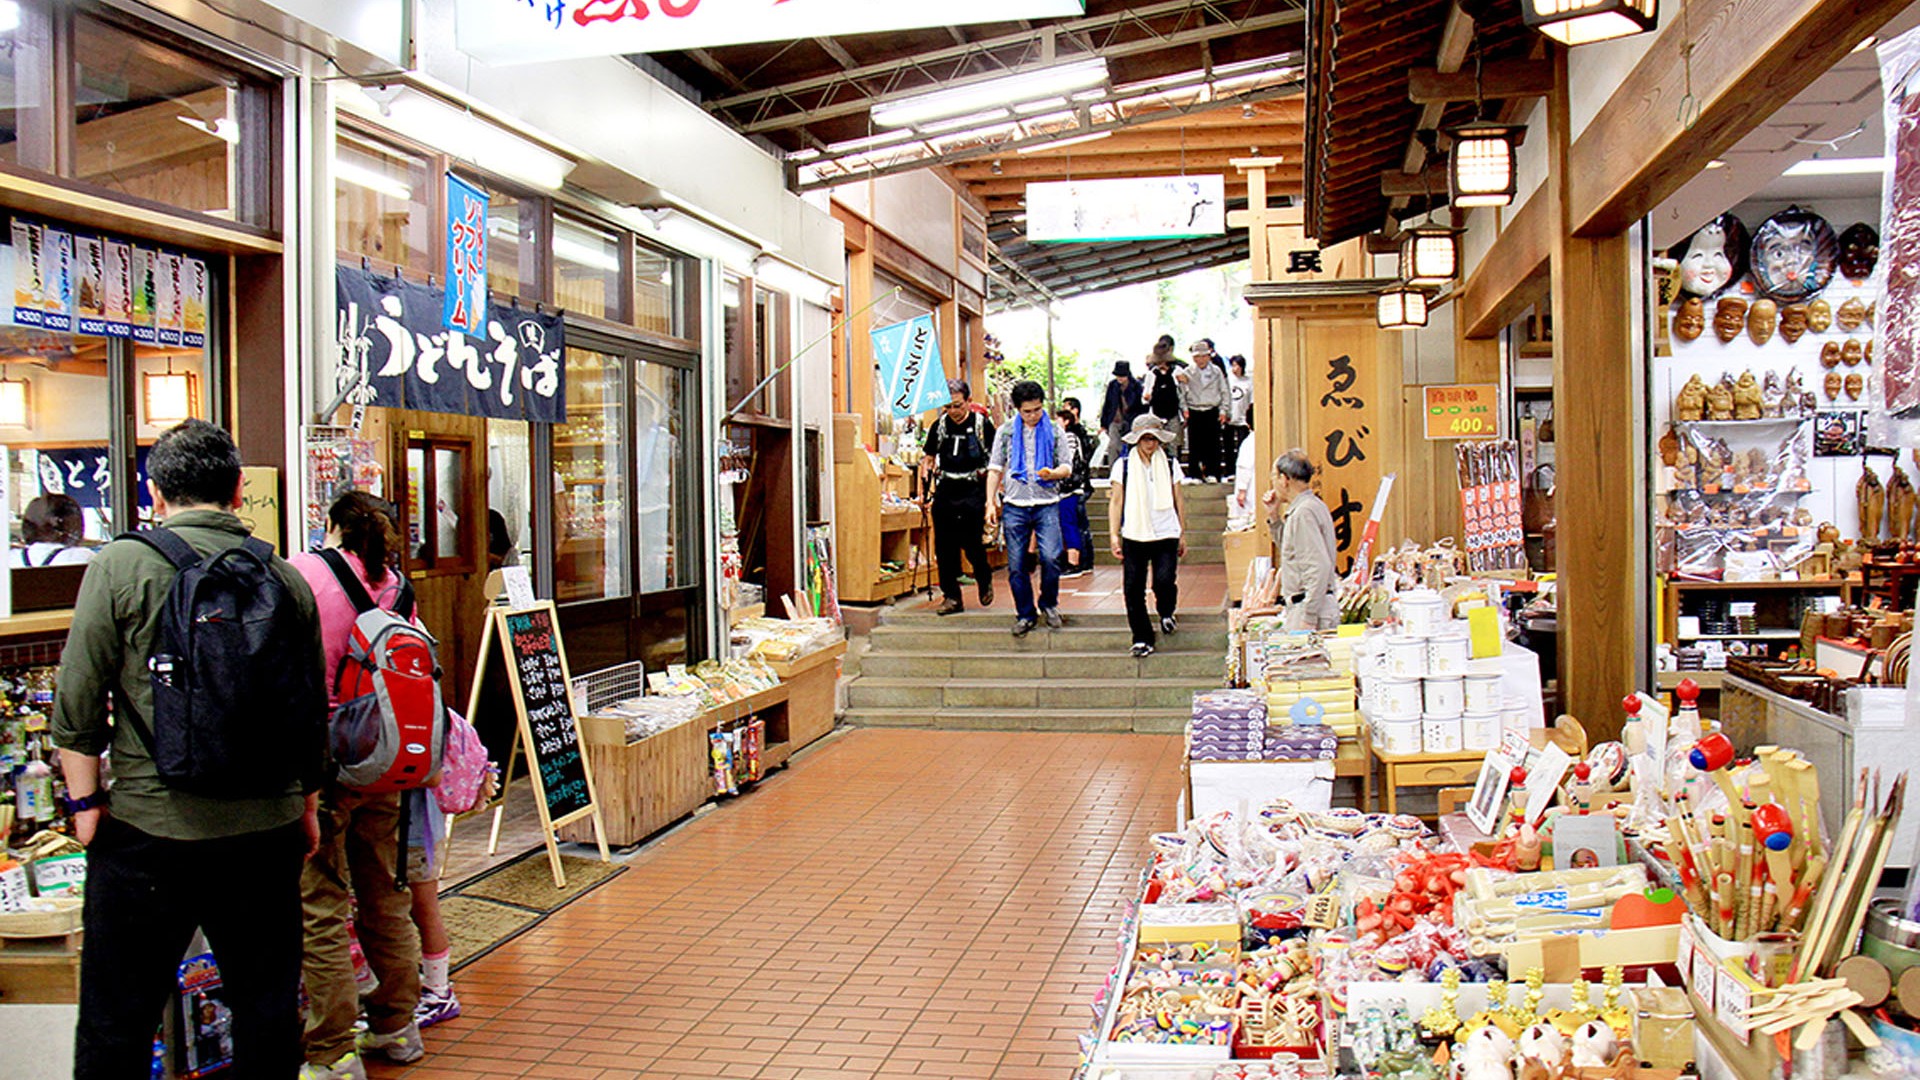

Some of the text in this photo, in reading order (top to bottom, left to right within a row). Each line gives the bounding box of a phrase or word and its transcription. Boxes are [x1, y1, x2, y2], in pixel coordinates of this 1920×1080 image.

[452, 218, 467, 327] クリーム
[463, 194, 478, 284] ソフト
[1286, 250, 1323, 274] 民
[896, 327, 928, 410] ところてん
[1320, 355, 1370, 580] ゑびす
